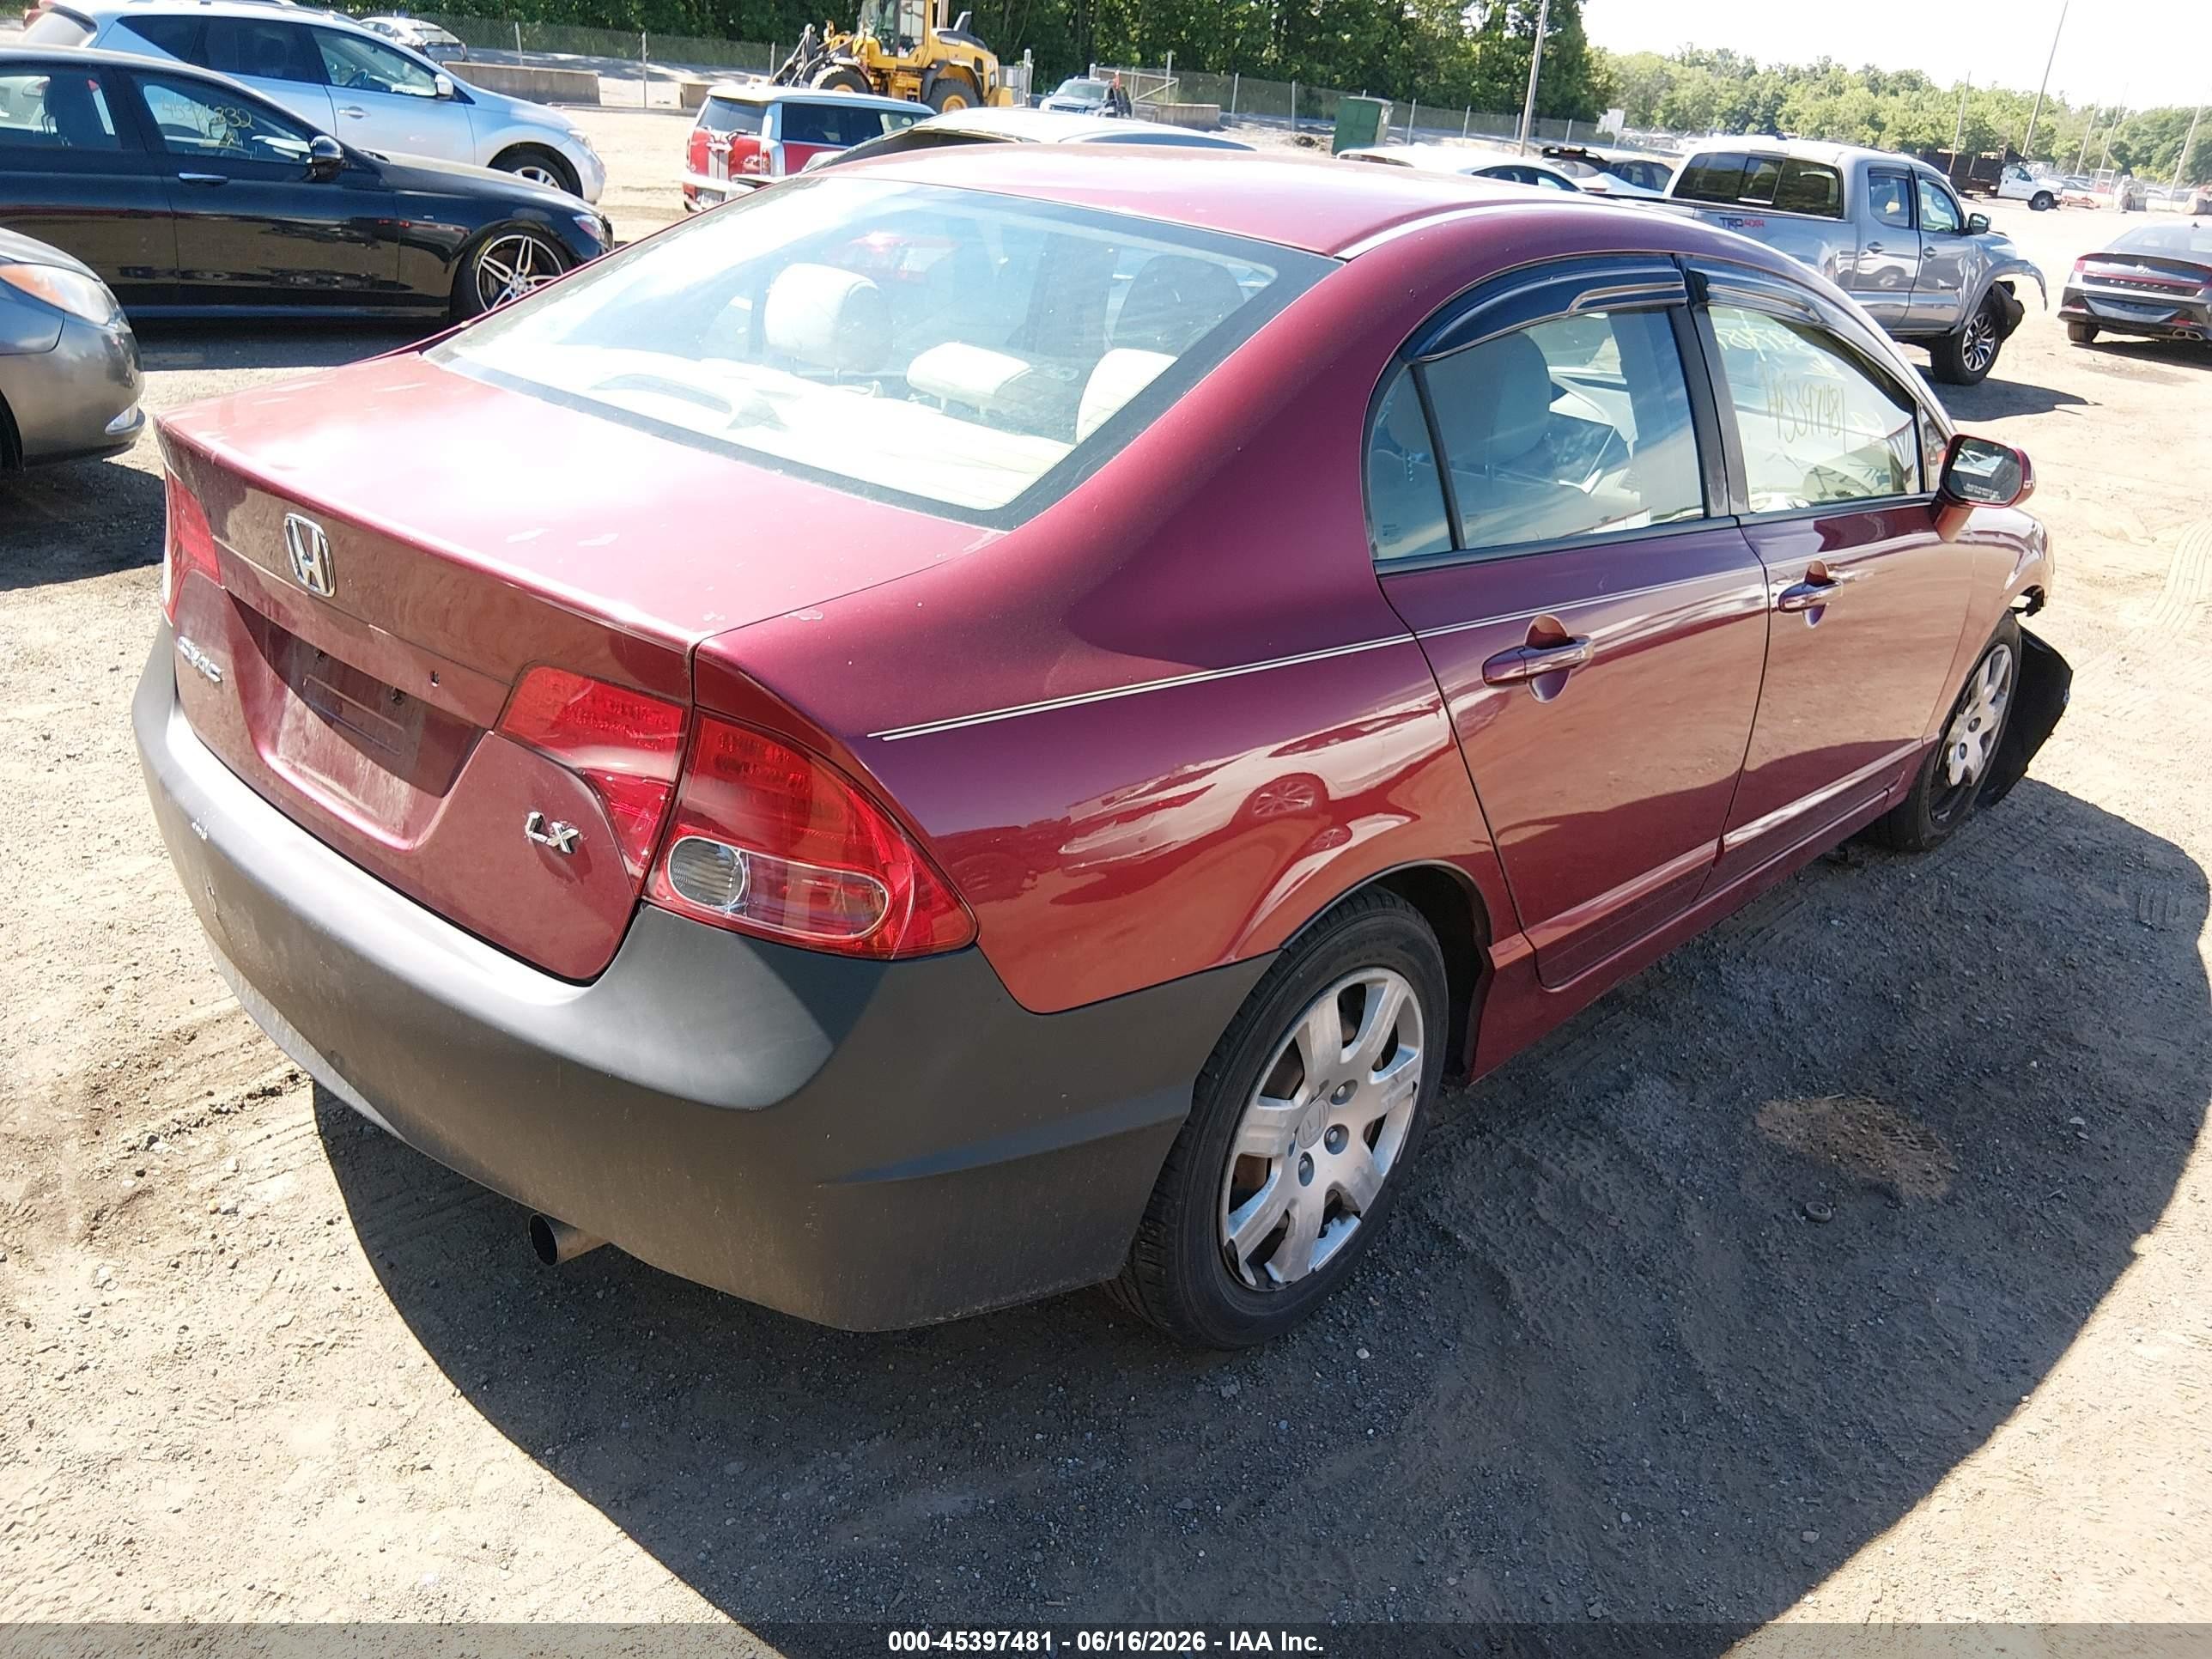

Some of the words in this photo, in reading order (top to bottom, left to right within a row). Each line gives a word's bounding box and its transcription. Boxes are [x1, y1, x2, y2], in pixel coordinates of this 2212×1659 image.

[1719, 216, 1744, 230] TRD
[177, 635, 222, 683] CIVIC
[525, 811, 580, 854] LX
